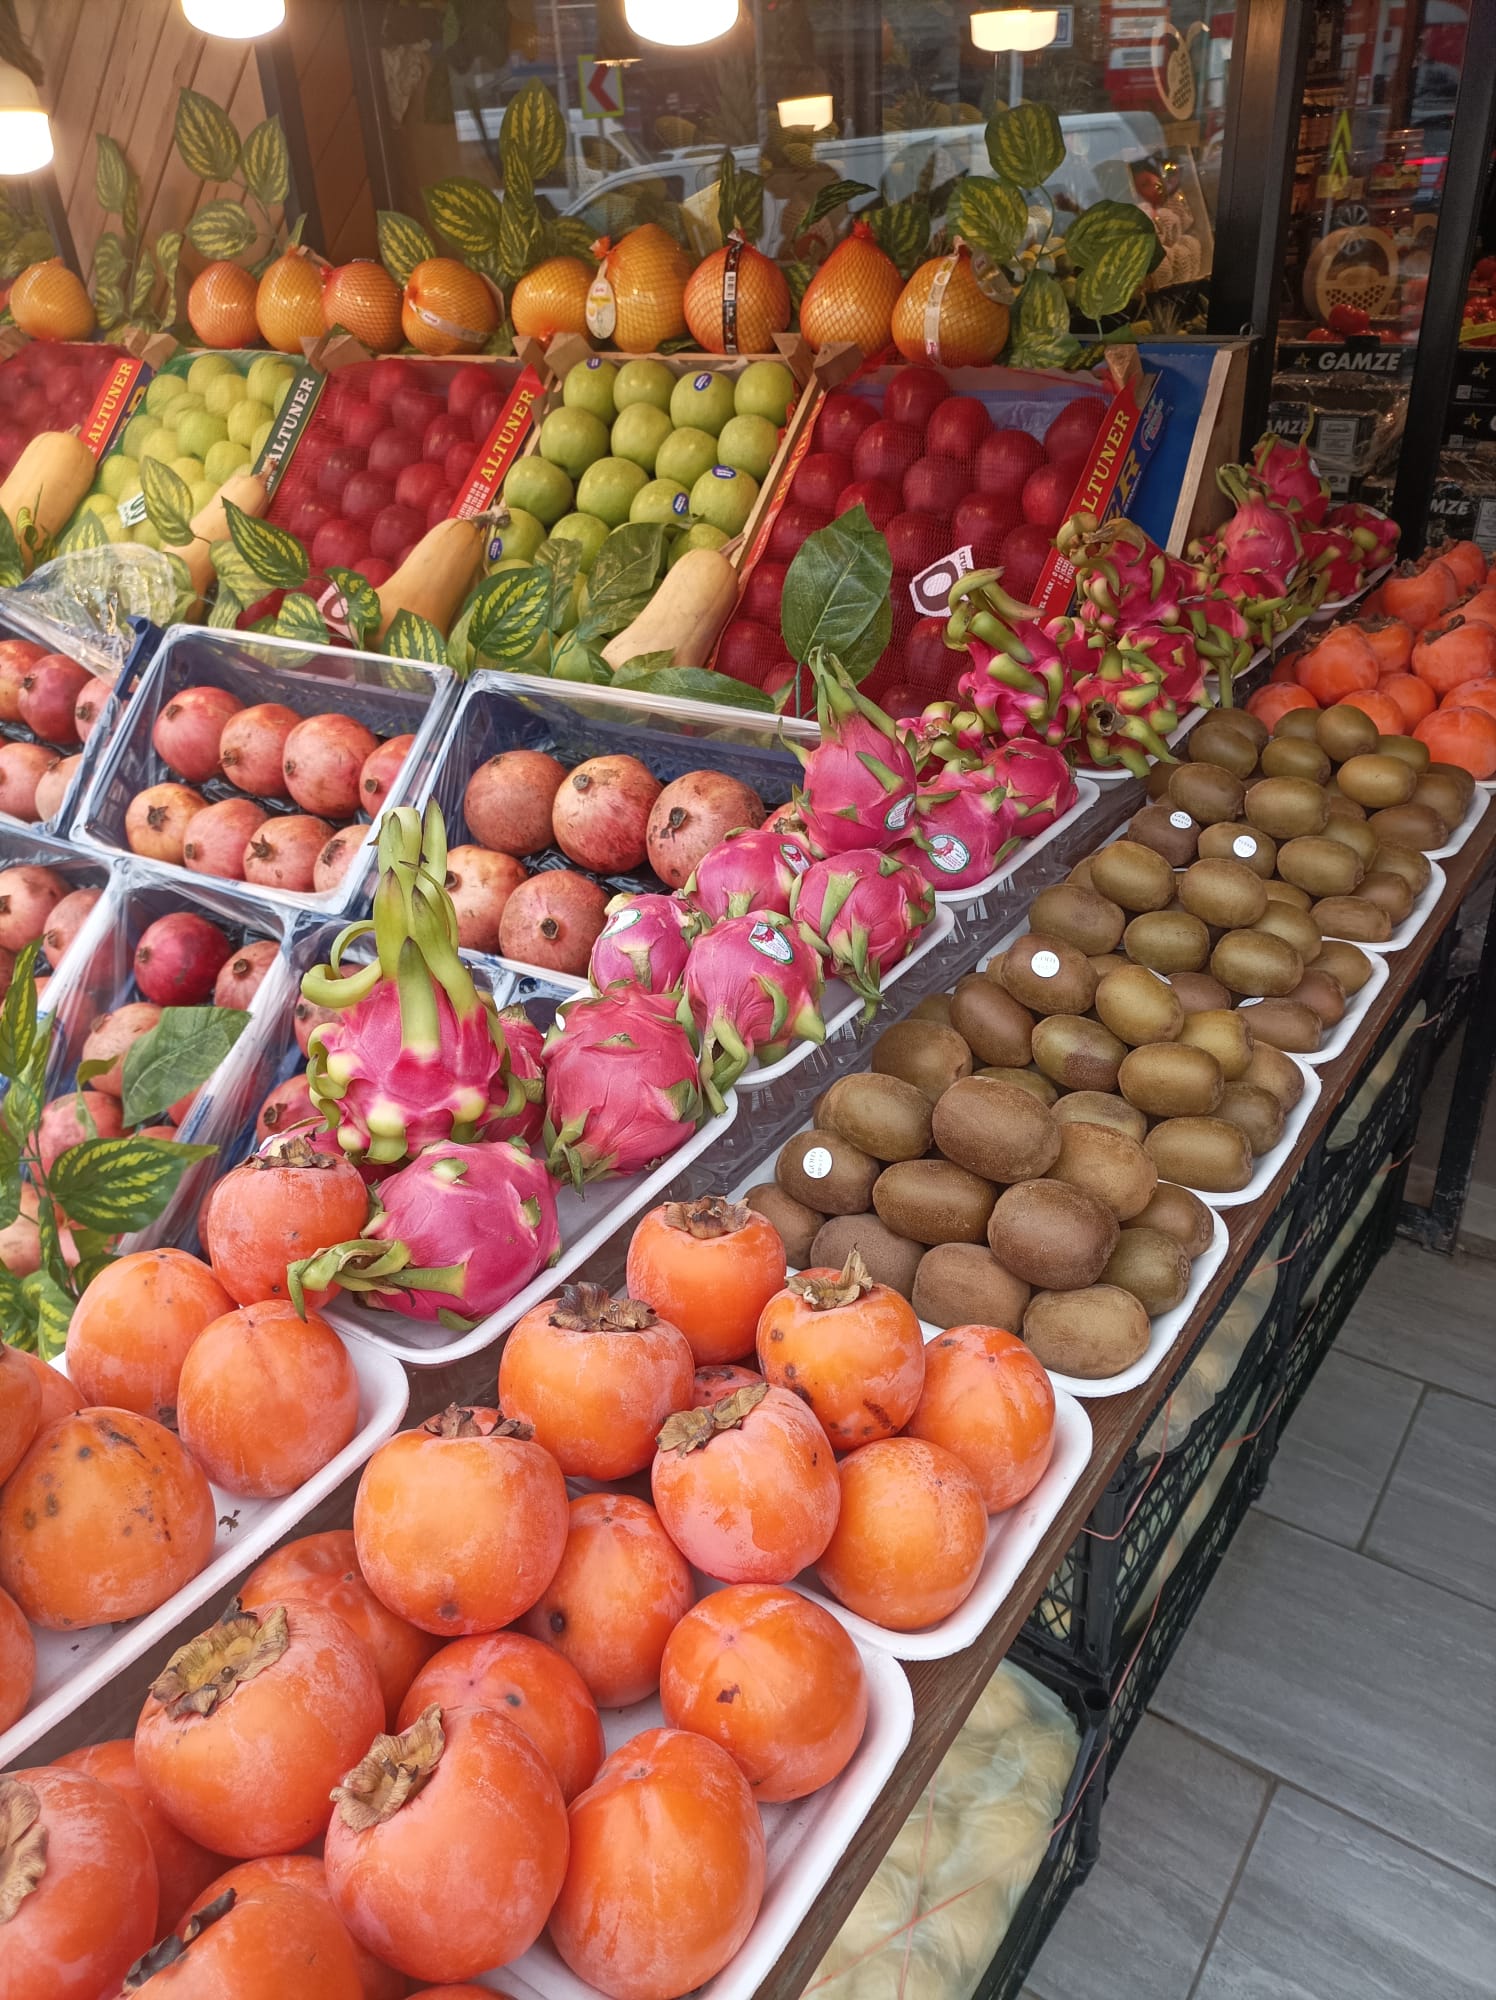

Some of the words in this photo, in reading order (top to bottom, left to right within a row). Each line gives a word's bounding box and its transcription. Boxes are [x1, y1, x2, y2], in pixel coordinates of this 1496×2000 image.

[88, 363, 133, 443] ALTUNER
[1318, 352, 1400, 371] GAMZE
[270, 377, 316, 464] ALTUNER
[480, 389, 535, 482] ALTUNER
[1081, 409, 1130, 512] LTUNER
[1430, 500, 1471, 515] MZE
